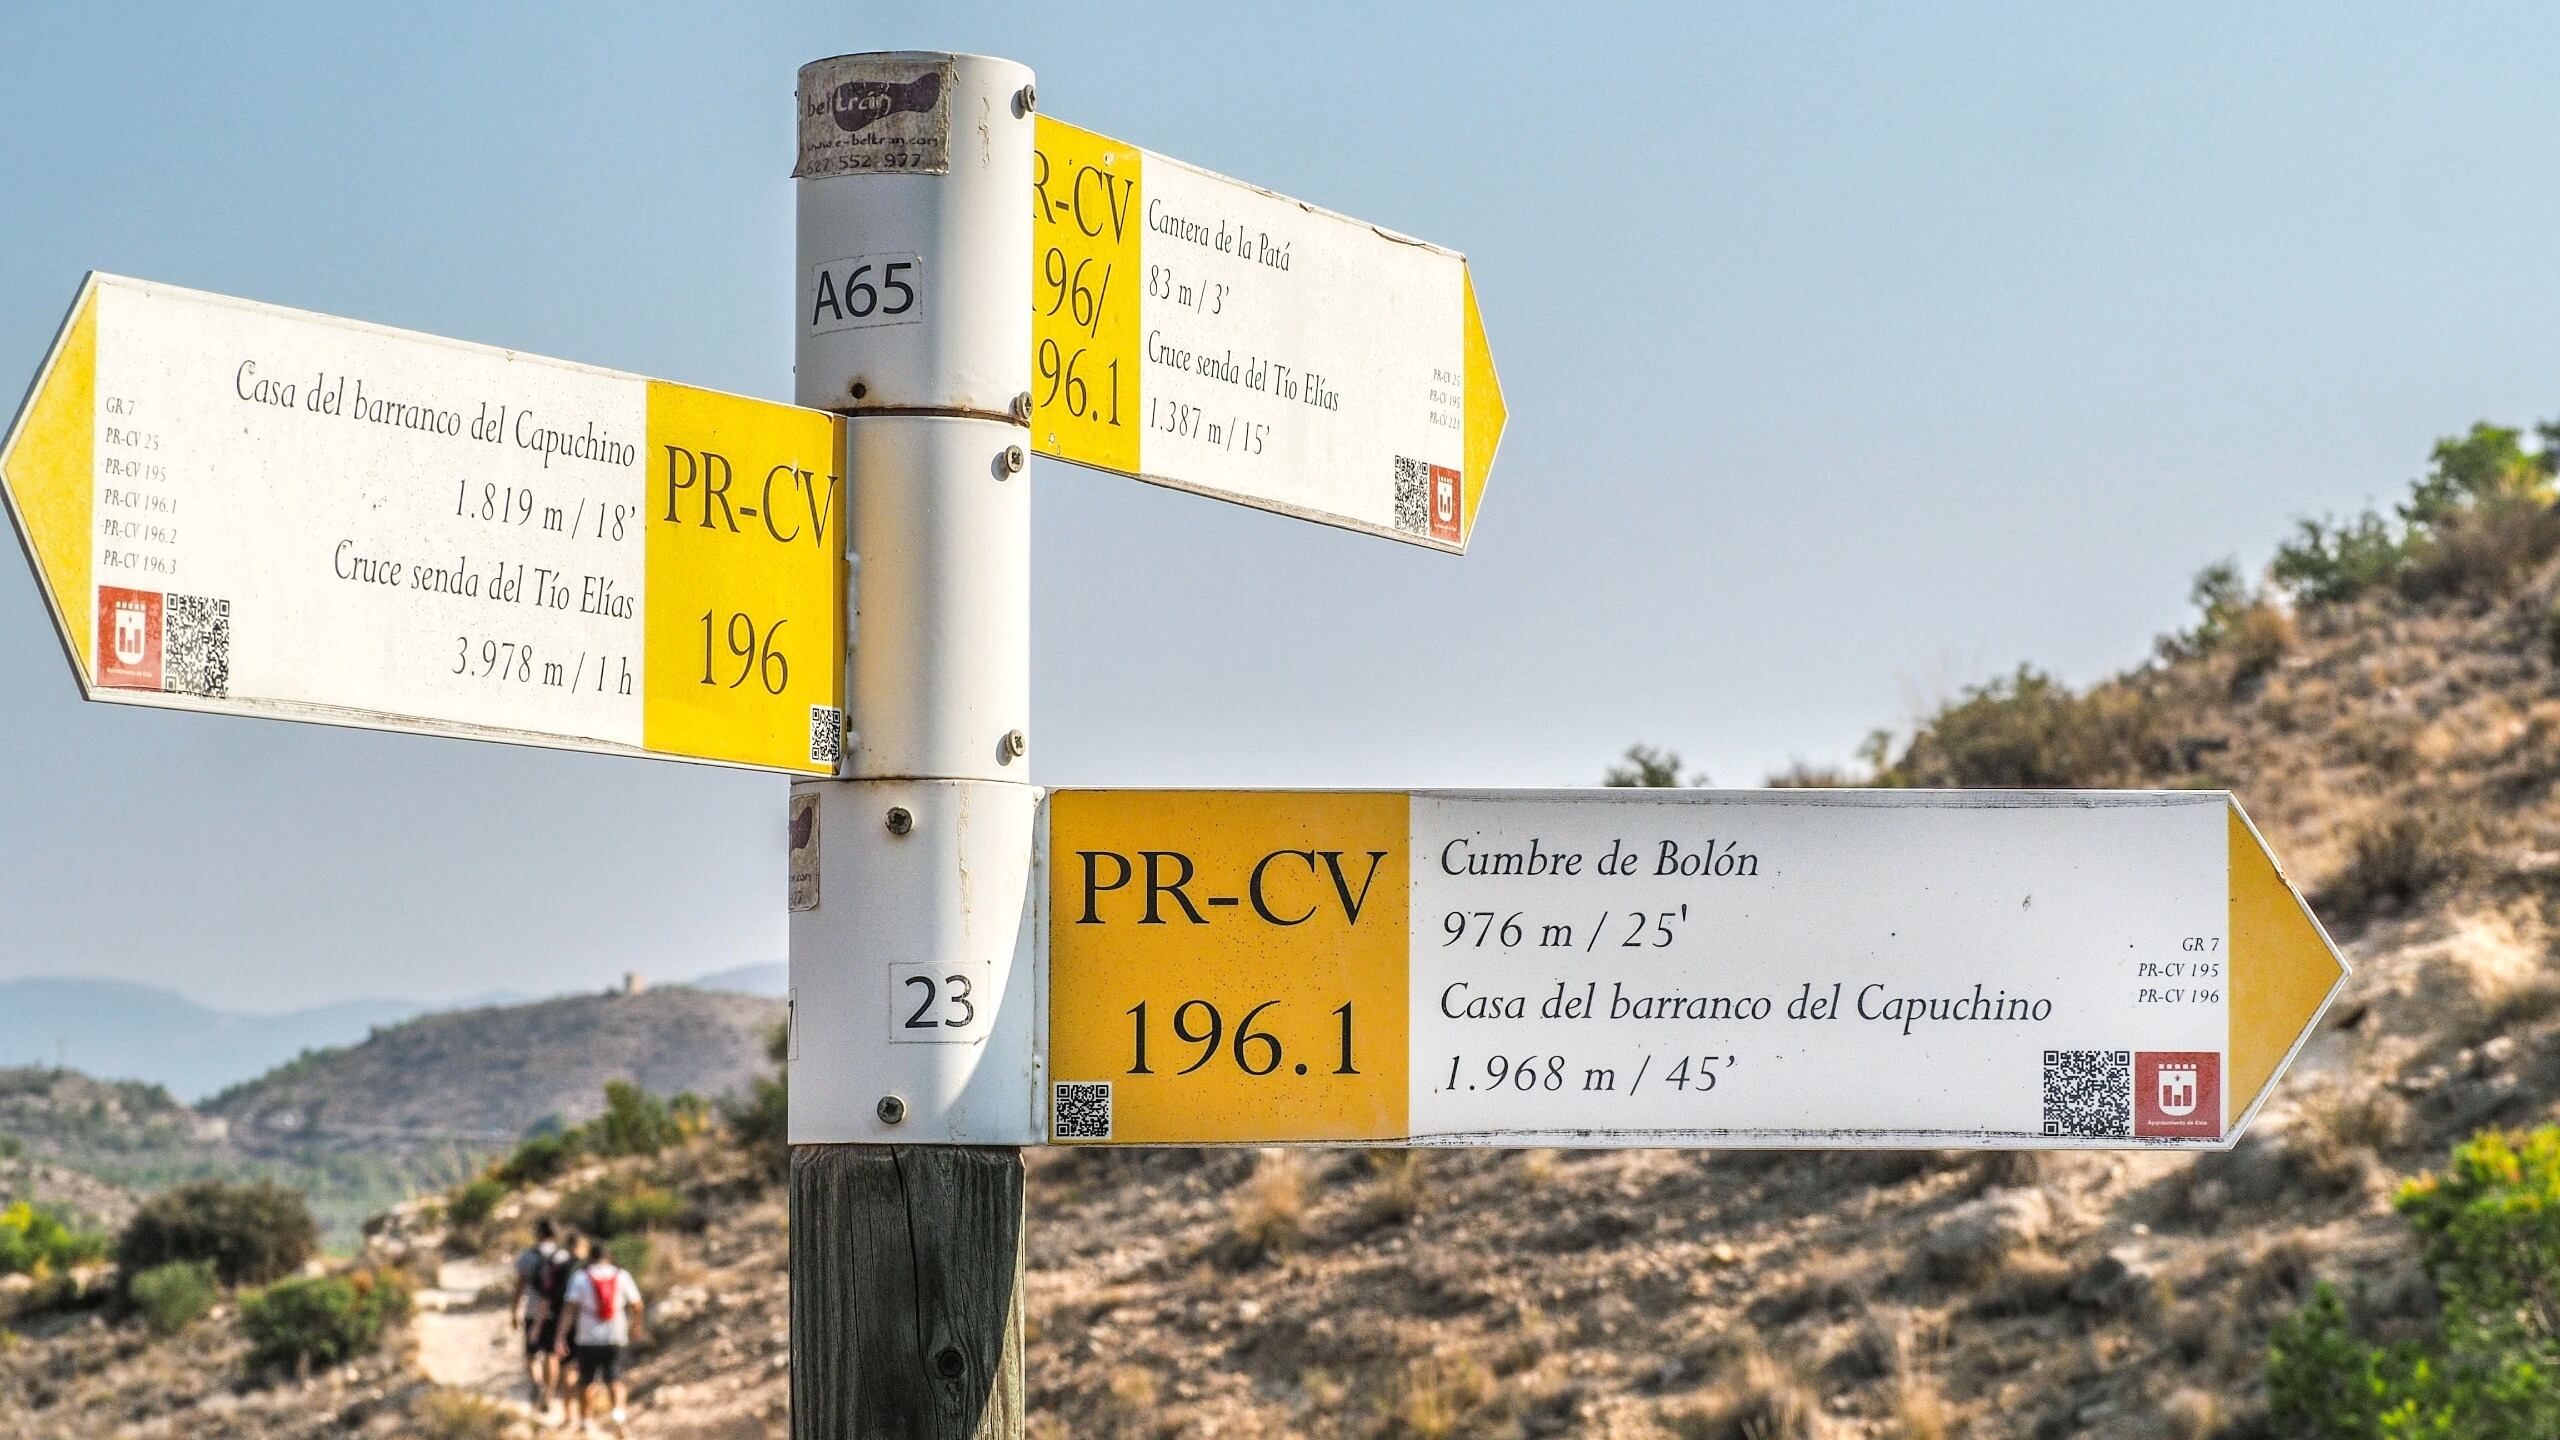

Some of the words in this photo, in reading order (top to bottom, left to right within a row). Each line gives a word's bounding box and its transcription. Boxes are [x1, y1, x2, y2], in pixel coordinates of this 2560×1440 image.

[839, 155, 871, 169] 552
[885, 153, 921, 168] 977
[1033, 150, 1134, 245] R-CV
[1149, 198, 1209, 247] Cantera
[1215, 220, 1233, 254] de
[1238, 228, 1252, 260] la
[1259, 233, 1291, 272] Patá
[813, 262, 914, 325] A65
[1033, 247, 1111, 338] 96/
[1149, 265, 1170, 302] 83
[1178, 286, 1193, 308] m
[1197, 279, 1207, 314] /
[1039, 338, 1121, 427] 96.1
[1149, 330, 1191, 373] Cruce
[1196, 350, 1240, 386] senda
[1245, 357, 1266, 393] del
[1274, 364, 1297, 400] Tío
[1304, 373, 1339, 413] Elías
[106, 397, 123, 414] GR
[128, 400, 135, 416] 7
[236, 360, 296, 408] Casa
[307, 372, 345, 416] del
[354, 380, 461, 436] barranco
[471, 402, 505, 443] del
[515, 410, 635, 468] Capuchino
[1149, 398, 1201, 440] 1.387
[1208, 421, 1222, 446] m
[1226, 416, 1237, 452] /
[106, 427, 141, 447] PR-CV
[144, 433, 159, 451] 25
[105, 458, 141, 477] PR-CV
[145, 464, 166, 482] 195
[664, 445, 838, 548] PR-CV
[104, 488, 140, 508] PR-CV
[144, 495, 177, 514] 196.1
[455, 479, 533, 525] 1.819
[543, 506, 564, 532] m
[571, 497, 586, 539] /
[104, 519, 140, 538] PR-CV
[144, 525, 177, 544] 196.2
[103, 549, 139, 569] PR-CV
[143, 555, 177, 575] 196.3
[335, 539, 402, 586] Cruce
[410, 556, 478, 597] senda
[488, 562, 524, 603] del
[534, 568, 570, 610] Tío
[579, 575, 634, 620] Elías
[452, 635, 533, 684] 3.978
[543, 660, 563, 687] m
[571, 651, 586, 693] /
[599, 655, 607, 692] 1
[618, 657, 632, 695] h
[700, 609, 789, 695] 196
[1441, 838, 1582, 877] Cumbre
[1597, 838, 1638, 877] de
[1653, 838, 1759, 877] Bolón
[1075, 849, 1388, 926] PR-CV
[1442, 910, 1523, 948] 976
[1540, 923, 1573, 948] m
[1586, 910, 1609, 953] /
[1621, 903, 1688, 948] 25'
[2182, 937, 2205, 952] GR
[2211, 937, 2220, 952] 7
[2138, 963, 2185, 977] PR-CV
[2191, 963, 2220, 978] 195
[2138, 989, 2185, 1003] PR-CV
[2191, 989, 2220, 1004] 196
[904, 975, 974, 1029] 23
[1441, 982, 1526, 1021] Casa
[1541, 982, 1595, 1021] del
[1610, 982, 1772, 1021] barranco
[1786, 982, 1840, 1021] del
[1856, 983, 2052, 1036] Capuchino
[1126, 999, 1360, 1076] 196.1
[1445, 1055, 1565, 1092] 1.968
[1583, 1067, 1616, 1092] m
[1630, 1054, 1651, 1096] /
